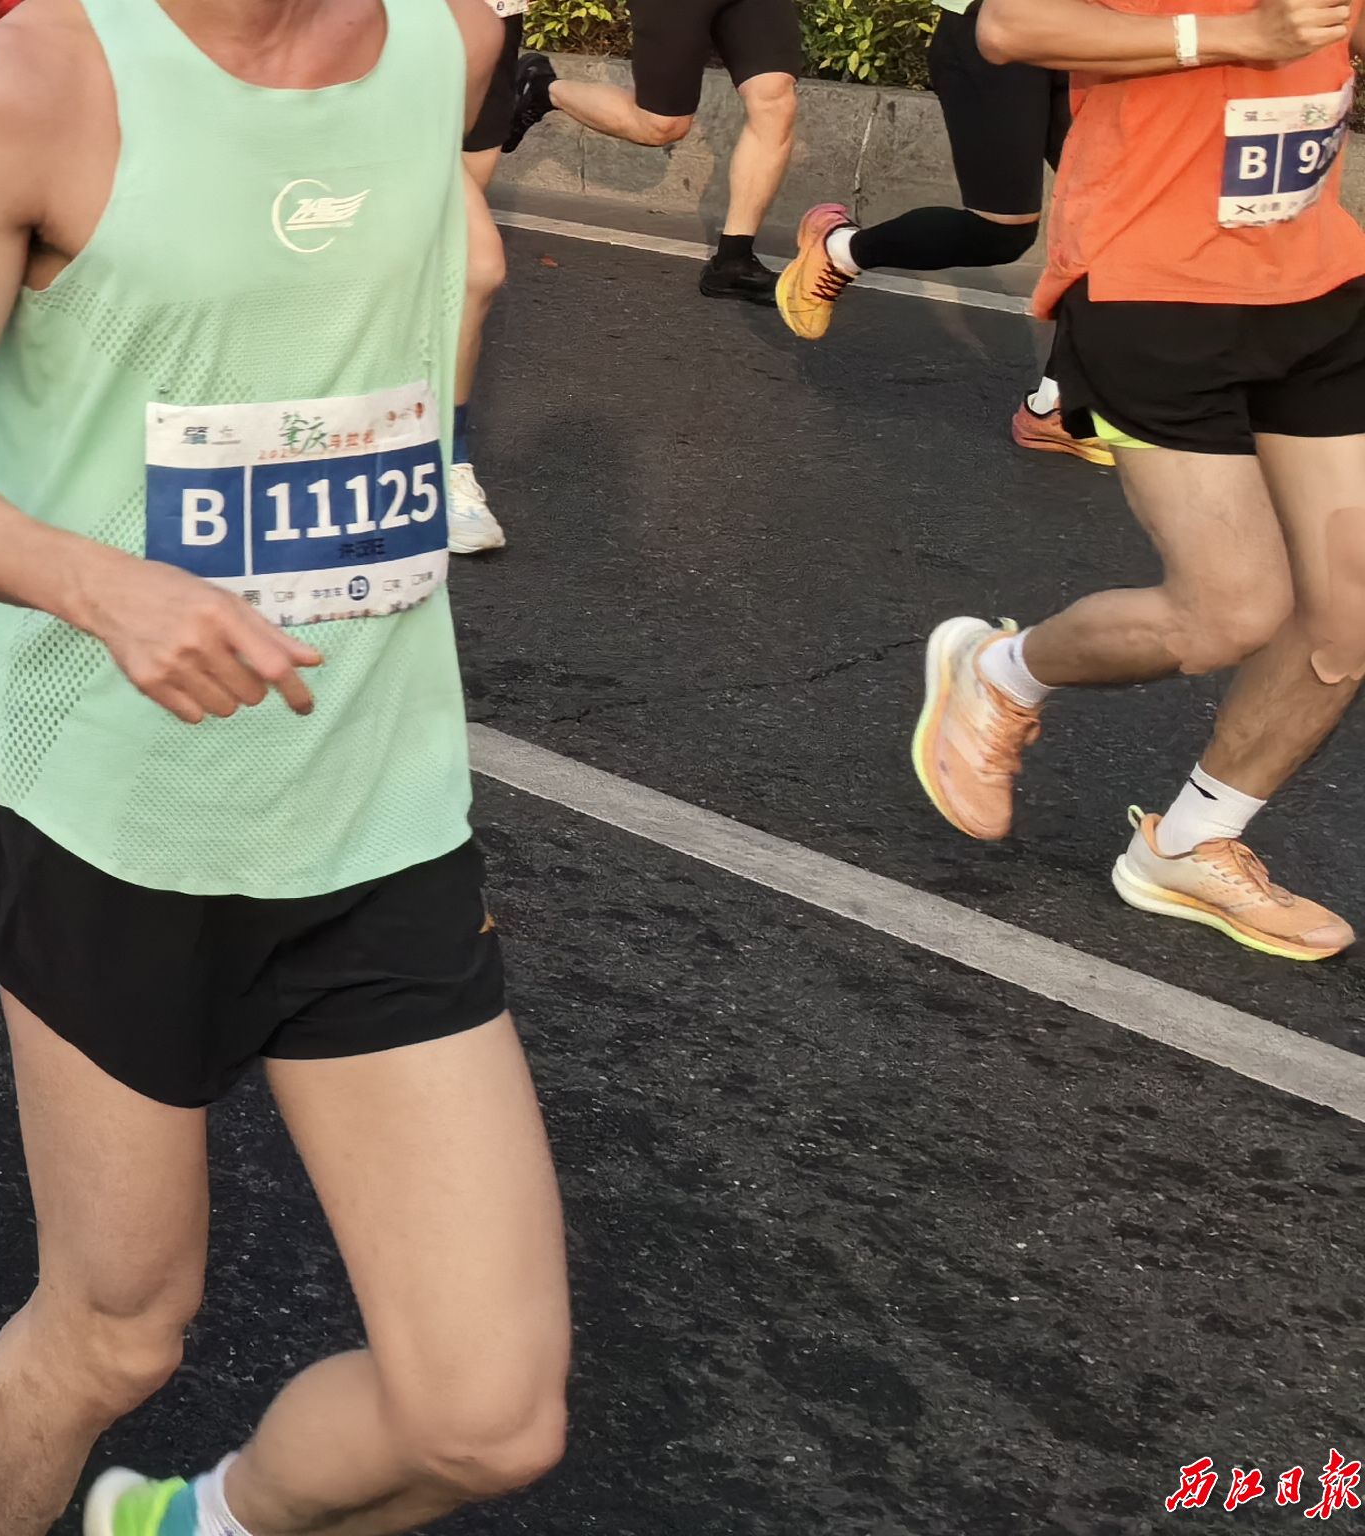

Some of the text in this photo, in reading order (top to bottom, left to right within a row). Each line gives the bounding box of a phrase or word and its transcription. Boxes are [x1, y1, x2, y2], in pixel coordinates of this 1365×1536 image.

[1239, 145, 1268, 181] B
[181, 463, 439, 546] B 11125
